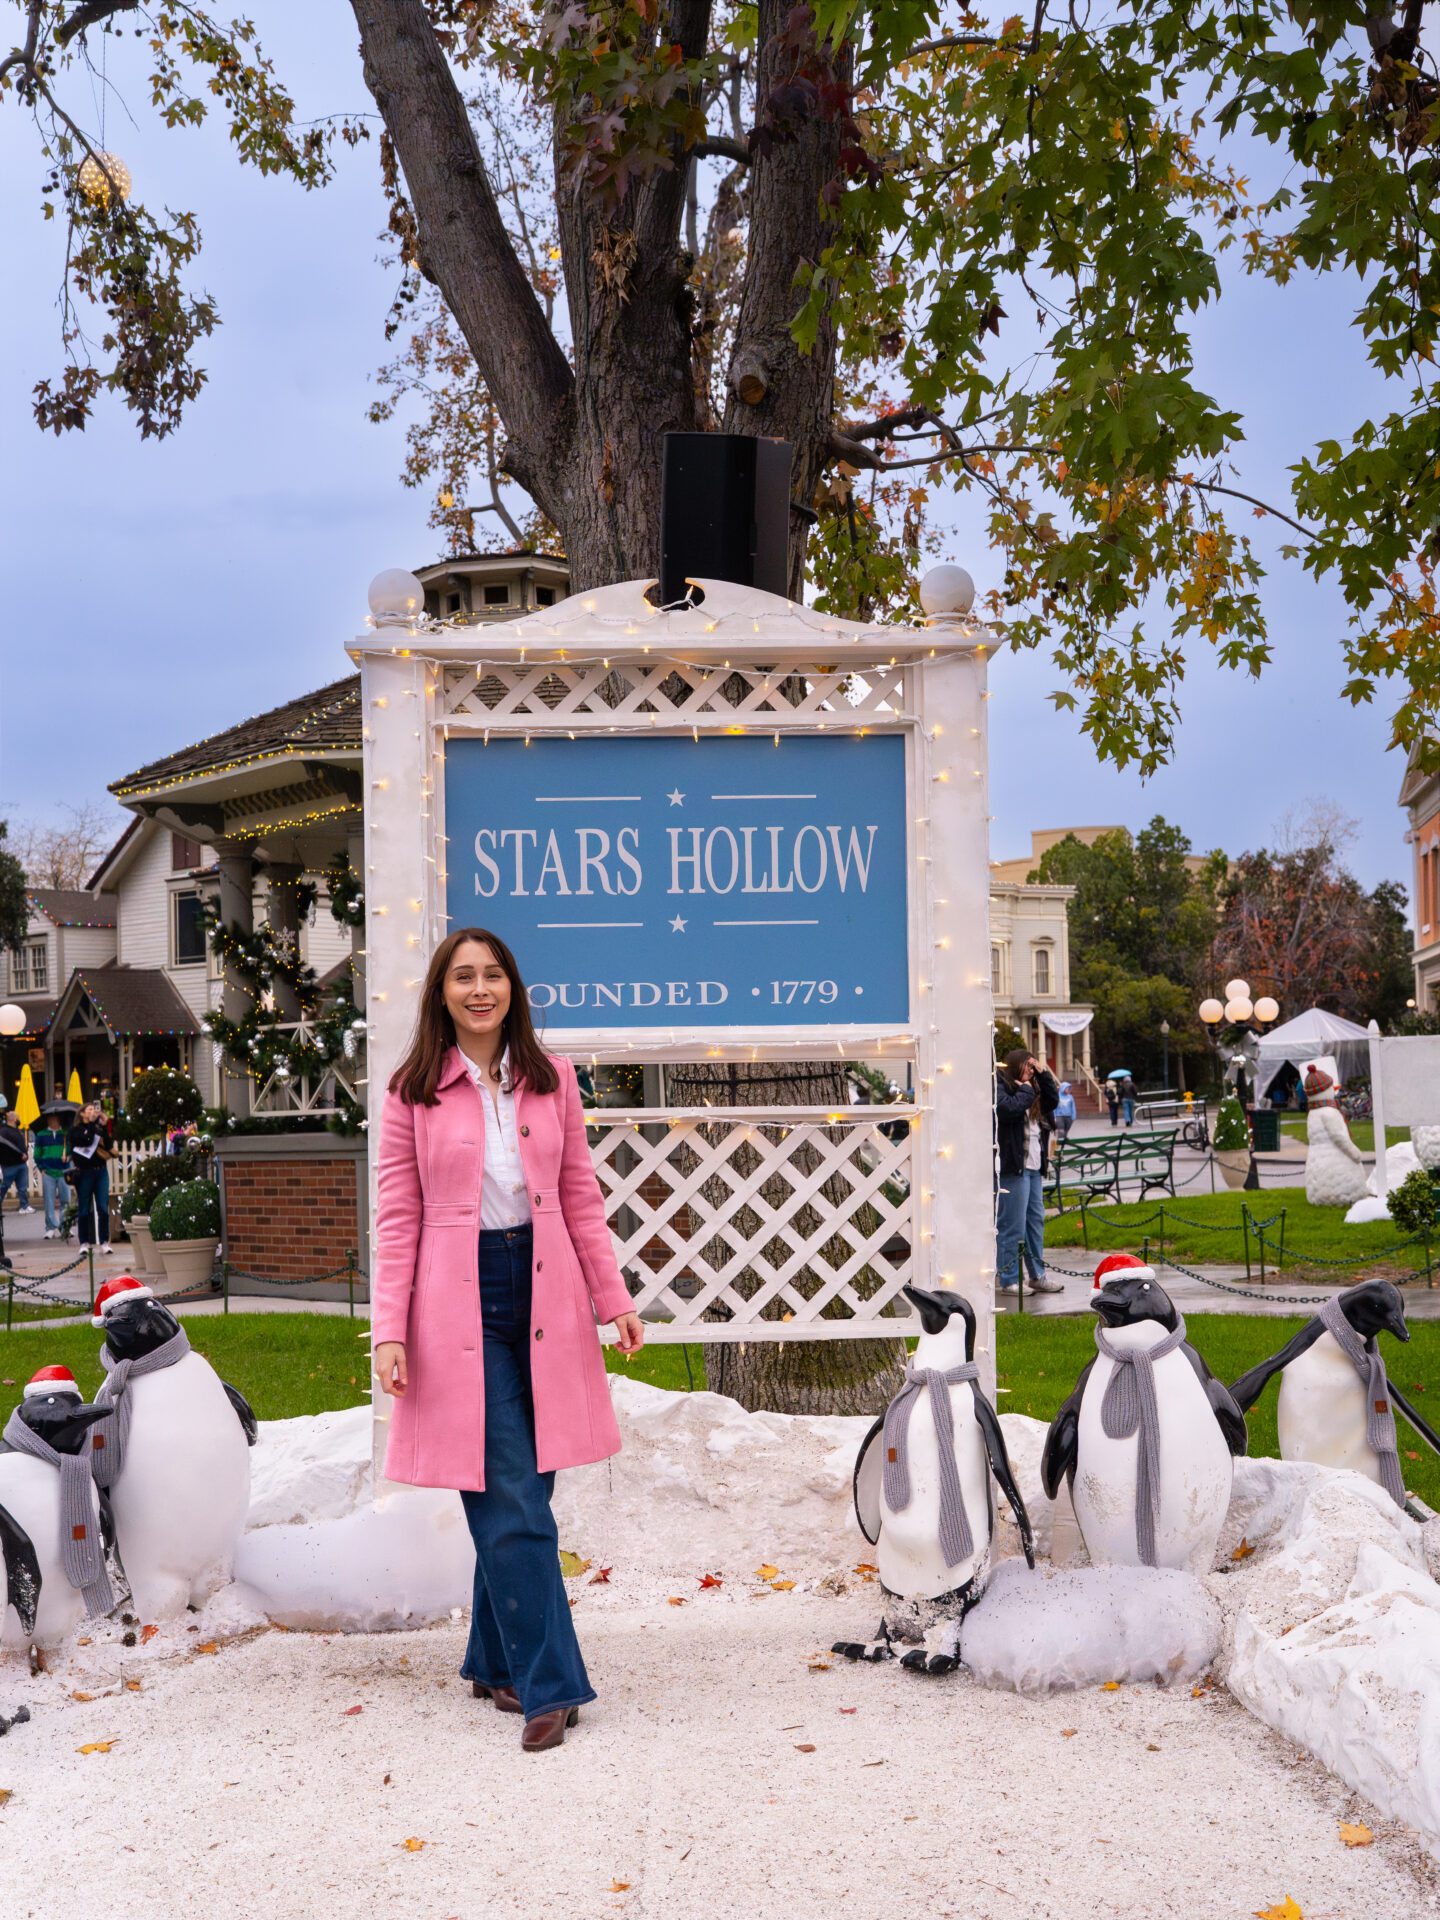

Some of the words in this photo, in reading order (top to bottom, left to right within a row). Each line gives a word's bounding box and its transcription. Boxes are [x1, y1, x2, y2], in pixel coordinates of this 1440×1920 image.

[474, 827, 643, 898] STARS
[665, 825, 879, 895] HOLLOW
[525, 981, 729, 1009] OUNDED
[770, 979, 839, 1005] 1779
